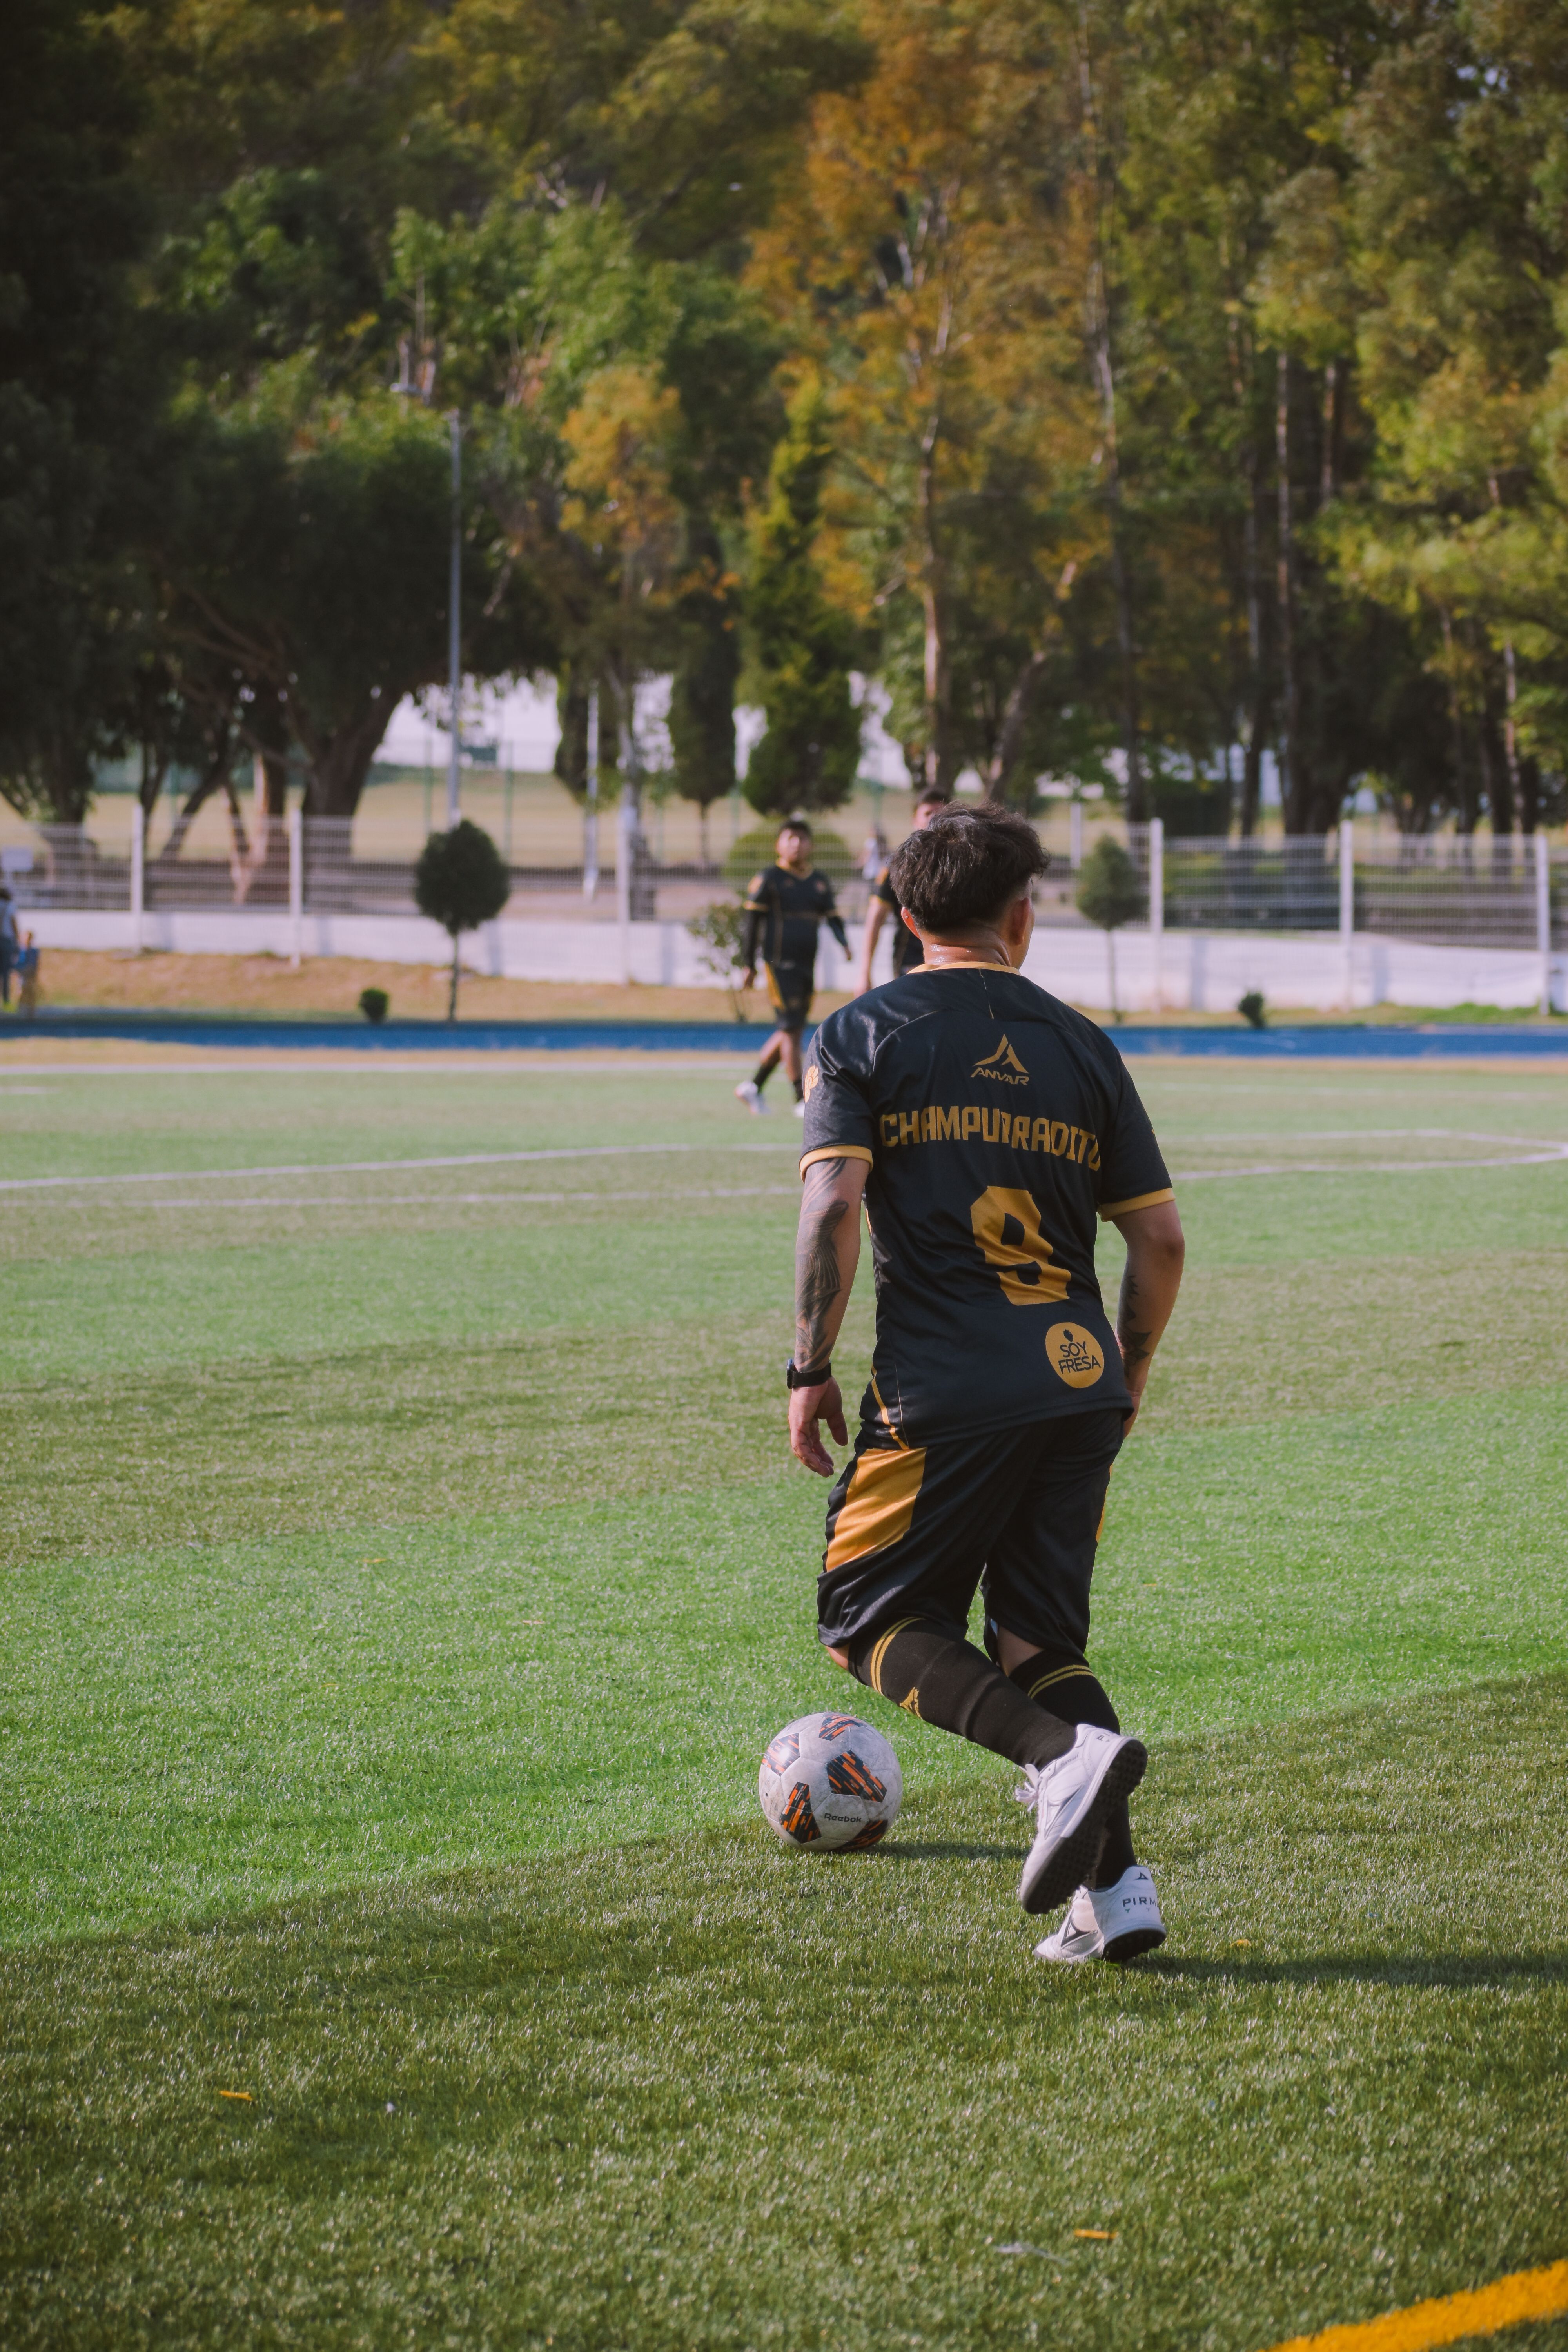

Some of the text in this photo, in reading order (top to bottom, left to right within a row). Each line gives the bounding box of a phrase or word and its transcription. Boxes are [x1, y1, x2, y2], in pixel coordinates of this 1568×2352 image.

[970, 1067, 1029, 1085] ANVAR
[1060, 1341, 1087, 1358] SOY
[1058, 1355, 1101, 1374] FRESA
[824, 1813, 862, 1822] Reebok
[1122, 1897, 1158, 1907] PIRM
